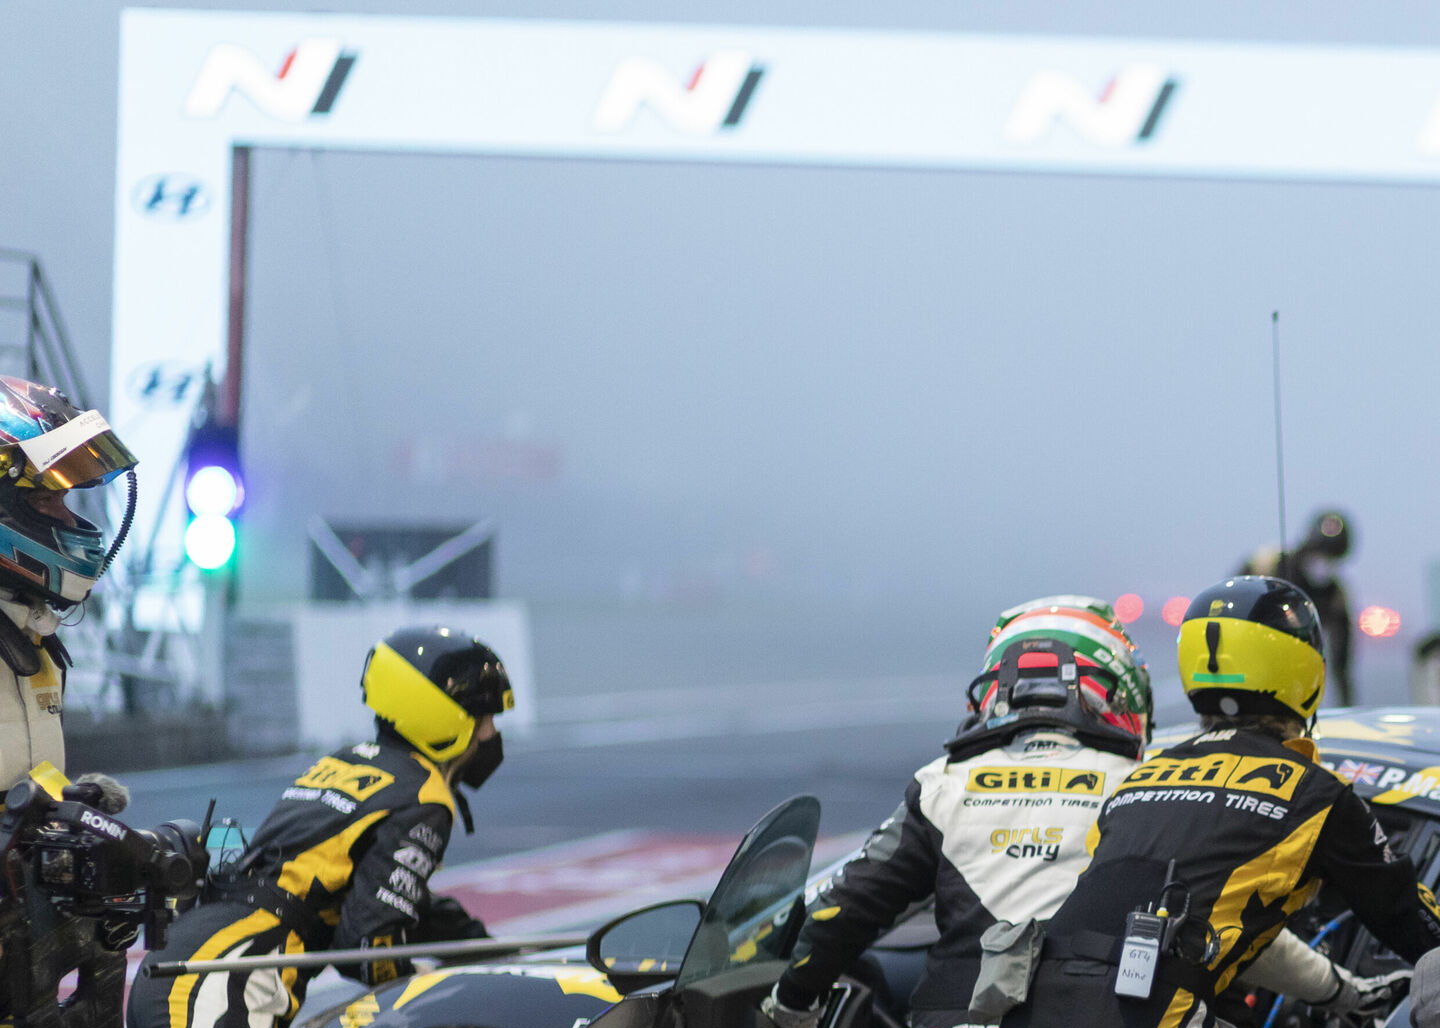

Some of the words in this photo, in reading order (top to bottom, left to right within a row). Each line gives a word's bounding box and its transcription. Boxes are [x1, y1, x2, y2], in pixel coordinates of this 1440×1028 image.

[974, 771, 1051, 790] Giti
[1123, 759, 1224, 783] Giti
[963, 797, 1053, 807] COMPETITION
[1061, 799, 1100, 809] TIRES
[1105, 789, 1215, 816] COMPETITION
[1225, 794, 1289, 820] TIRES
[80, 810, 127, 841] RONIN
[990, 827, 1064, 854] girls
[1005, 844, 1061, 862] only
